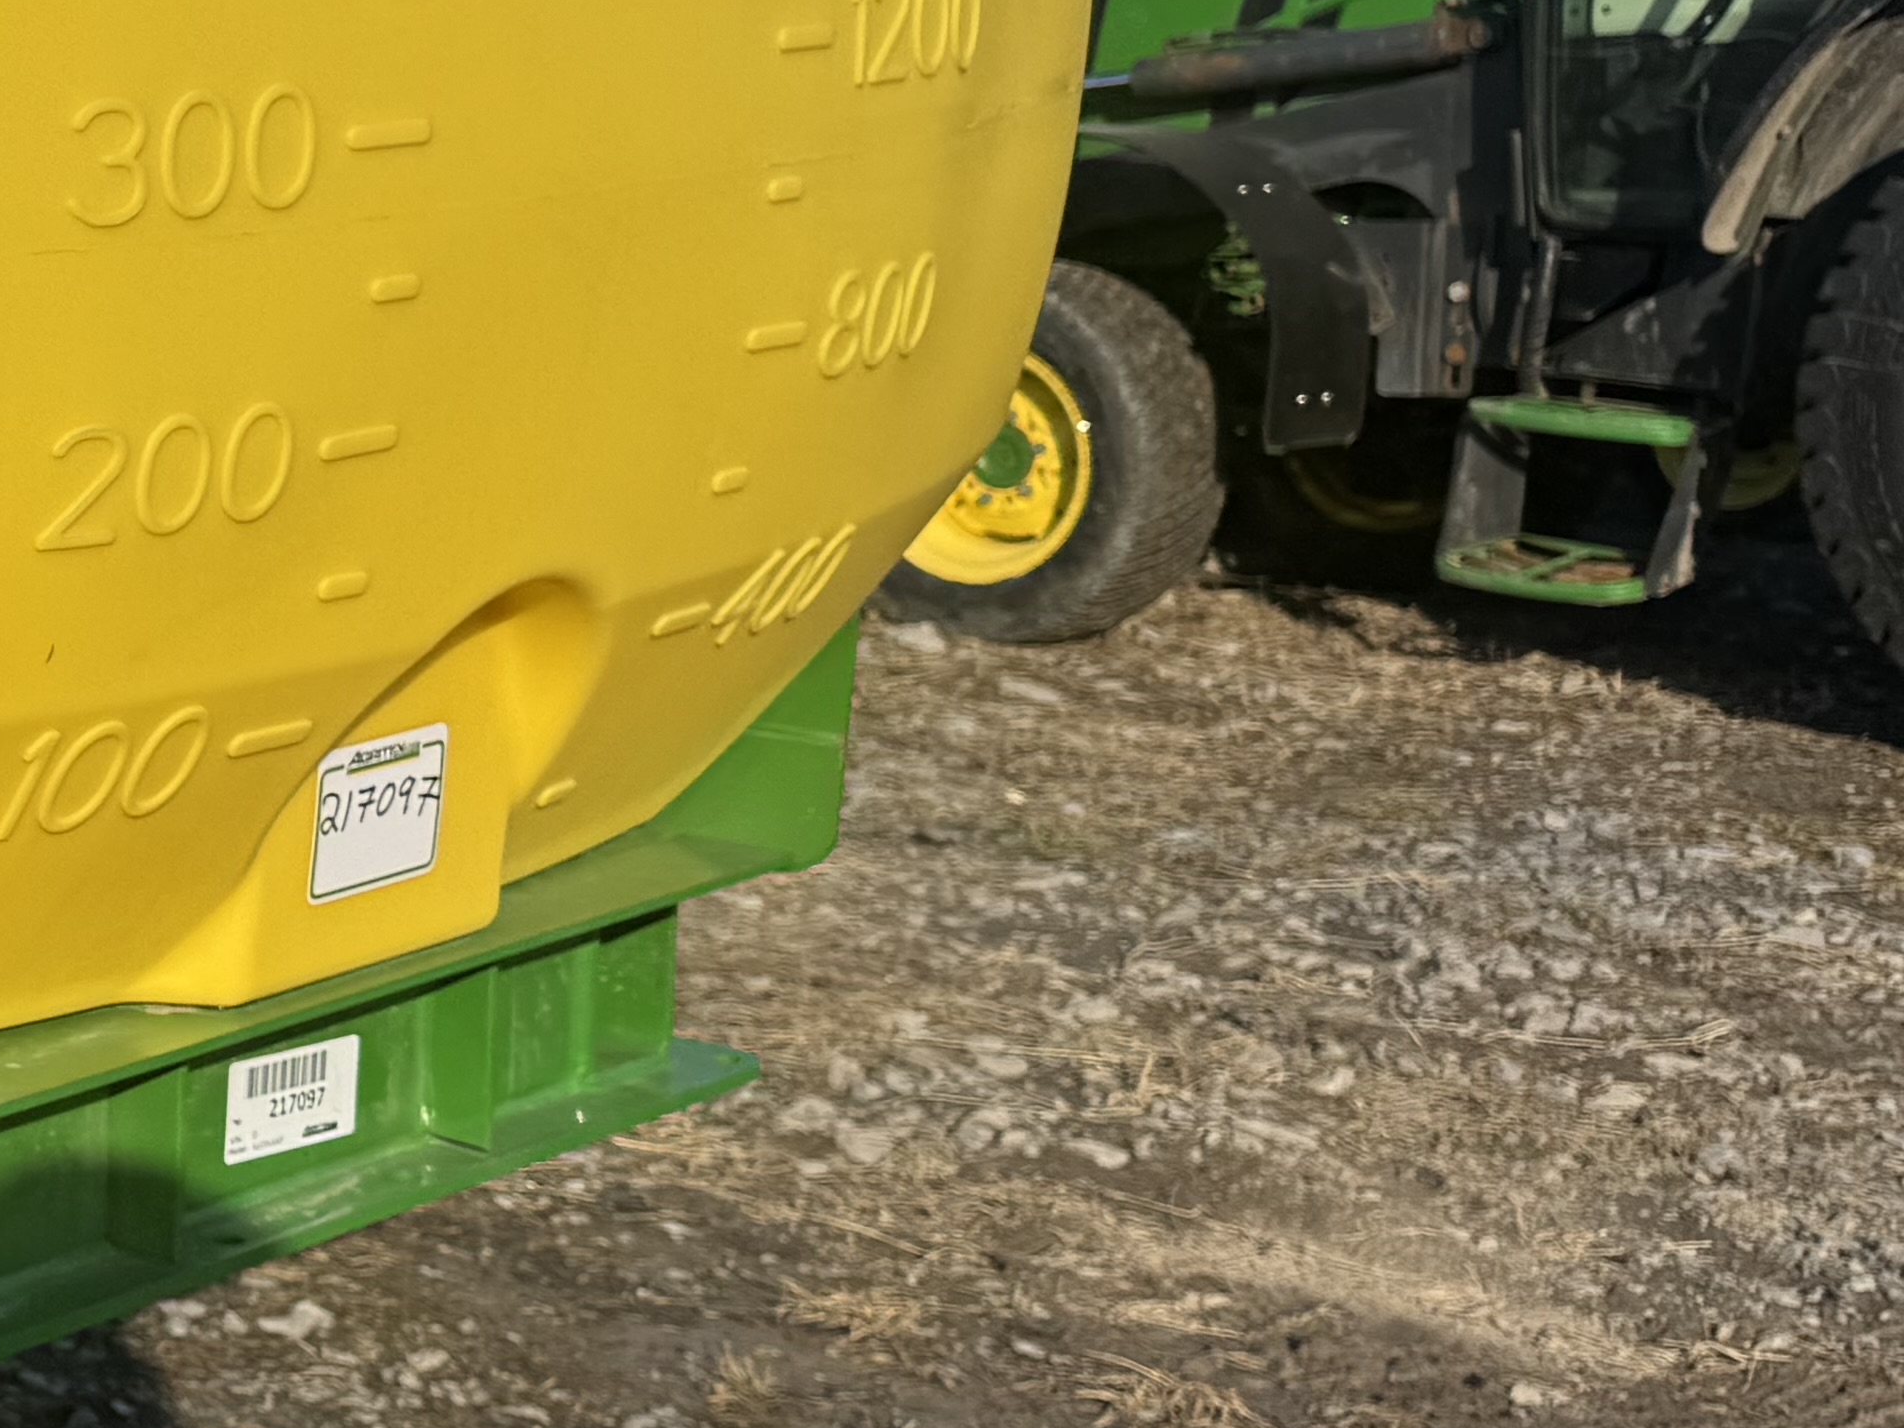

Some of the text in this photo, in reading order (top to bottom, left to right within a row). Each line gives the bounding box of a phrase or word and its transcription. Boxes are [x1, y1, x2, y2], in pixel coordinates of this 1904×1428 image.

[67, 82, 315, 227] 300
[818, 251, 935, 378] 800
[34, 401, 293, 551] 200
[711, 522, 857, 647] 400
[320, 775, 441, 836] 217097
[269, 1086, 326, 1118] 217097
